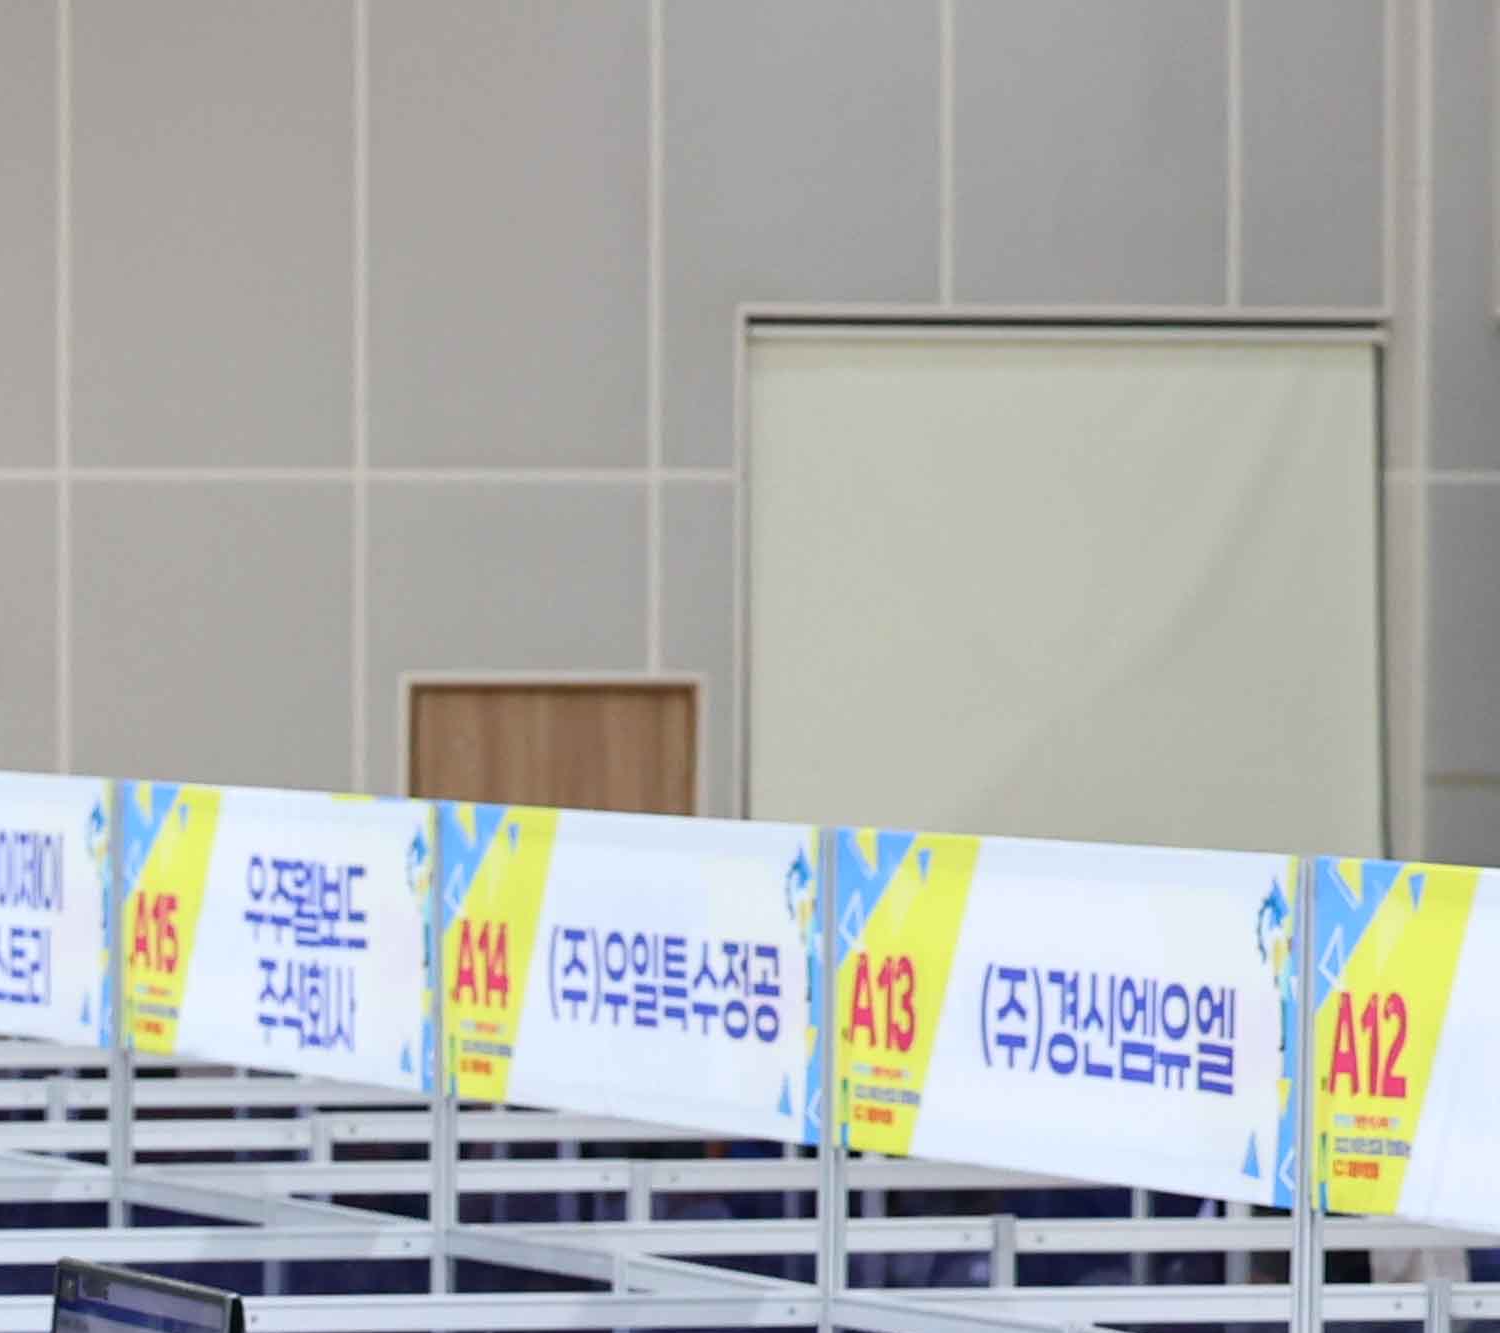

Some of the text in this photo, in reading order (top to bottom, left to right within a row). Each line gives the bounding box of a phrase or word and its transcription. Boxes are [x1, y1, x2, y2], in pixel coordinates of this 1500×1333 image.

[130, 893, 179, 975] A15
[452, 919, 510, 1010] A14
[549, 924, 782, 1046] (주)우일특수정공
[257, 957, 356, 1051] 주식회사
[849, 952, 917, 1056] A13
[980, 963, 1237, 1097] (주)경신엠유엘
[1330, 990, 1408, 1099] A12
